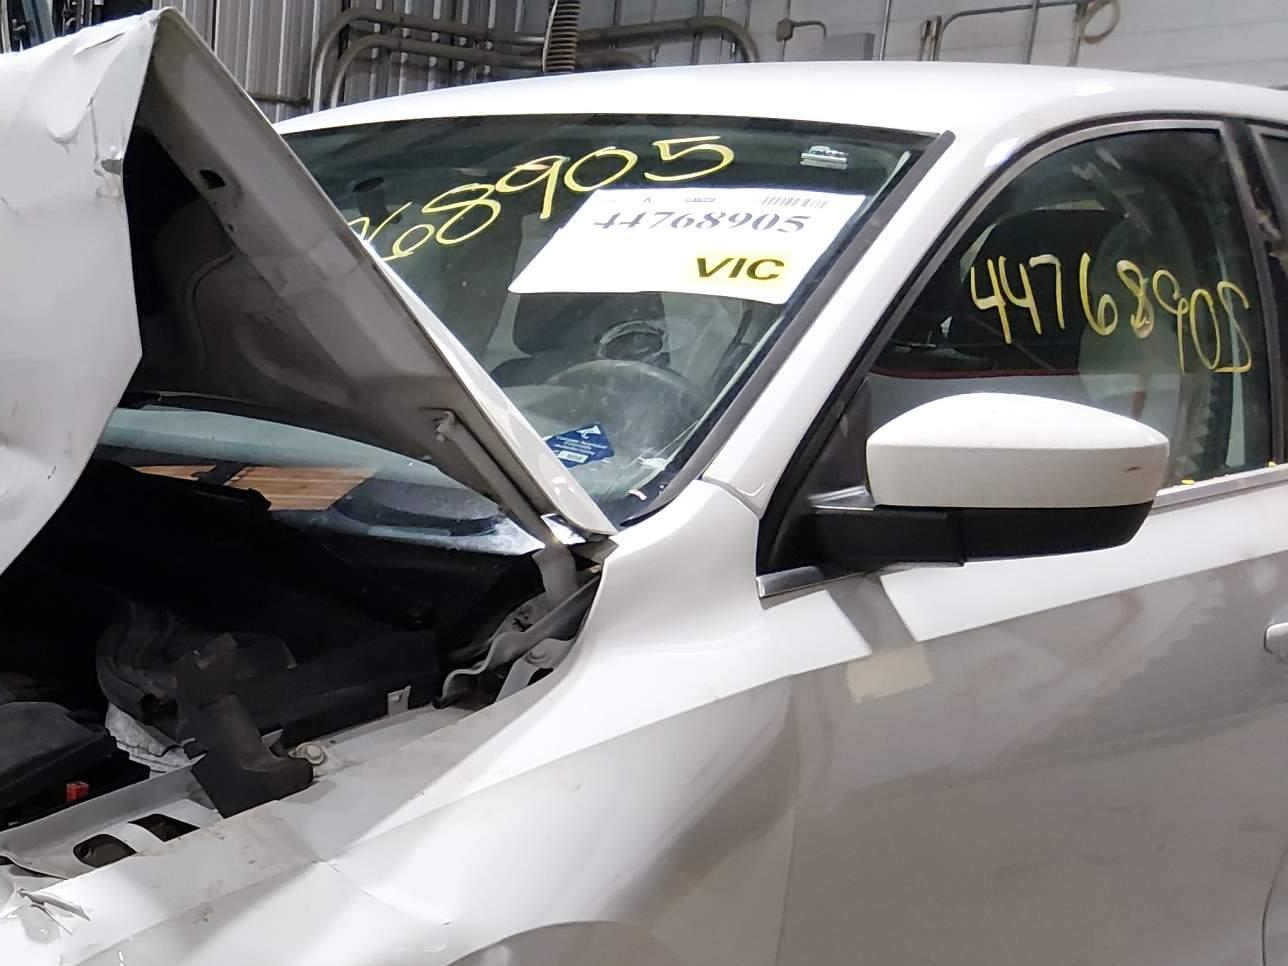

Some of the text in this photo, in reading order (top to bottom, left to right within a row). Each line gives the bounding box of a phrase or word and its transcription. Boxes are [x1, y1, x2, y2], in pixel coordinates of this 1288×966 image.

[594, 211, 811, 233] 44768905
[696, 257, 785, 281] VIC
[970, 252, 1252, 374] 44768905
